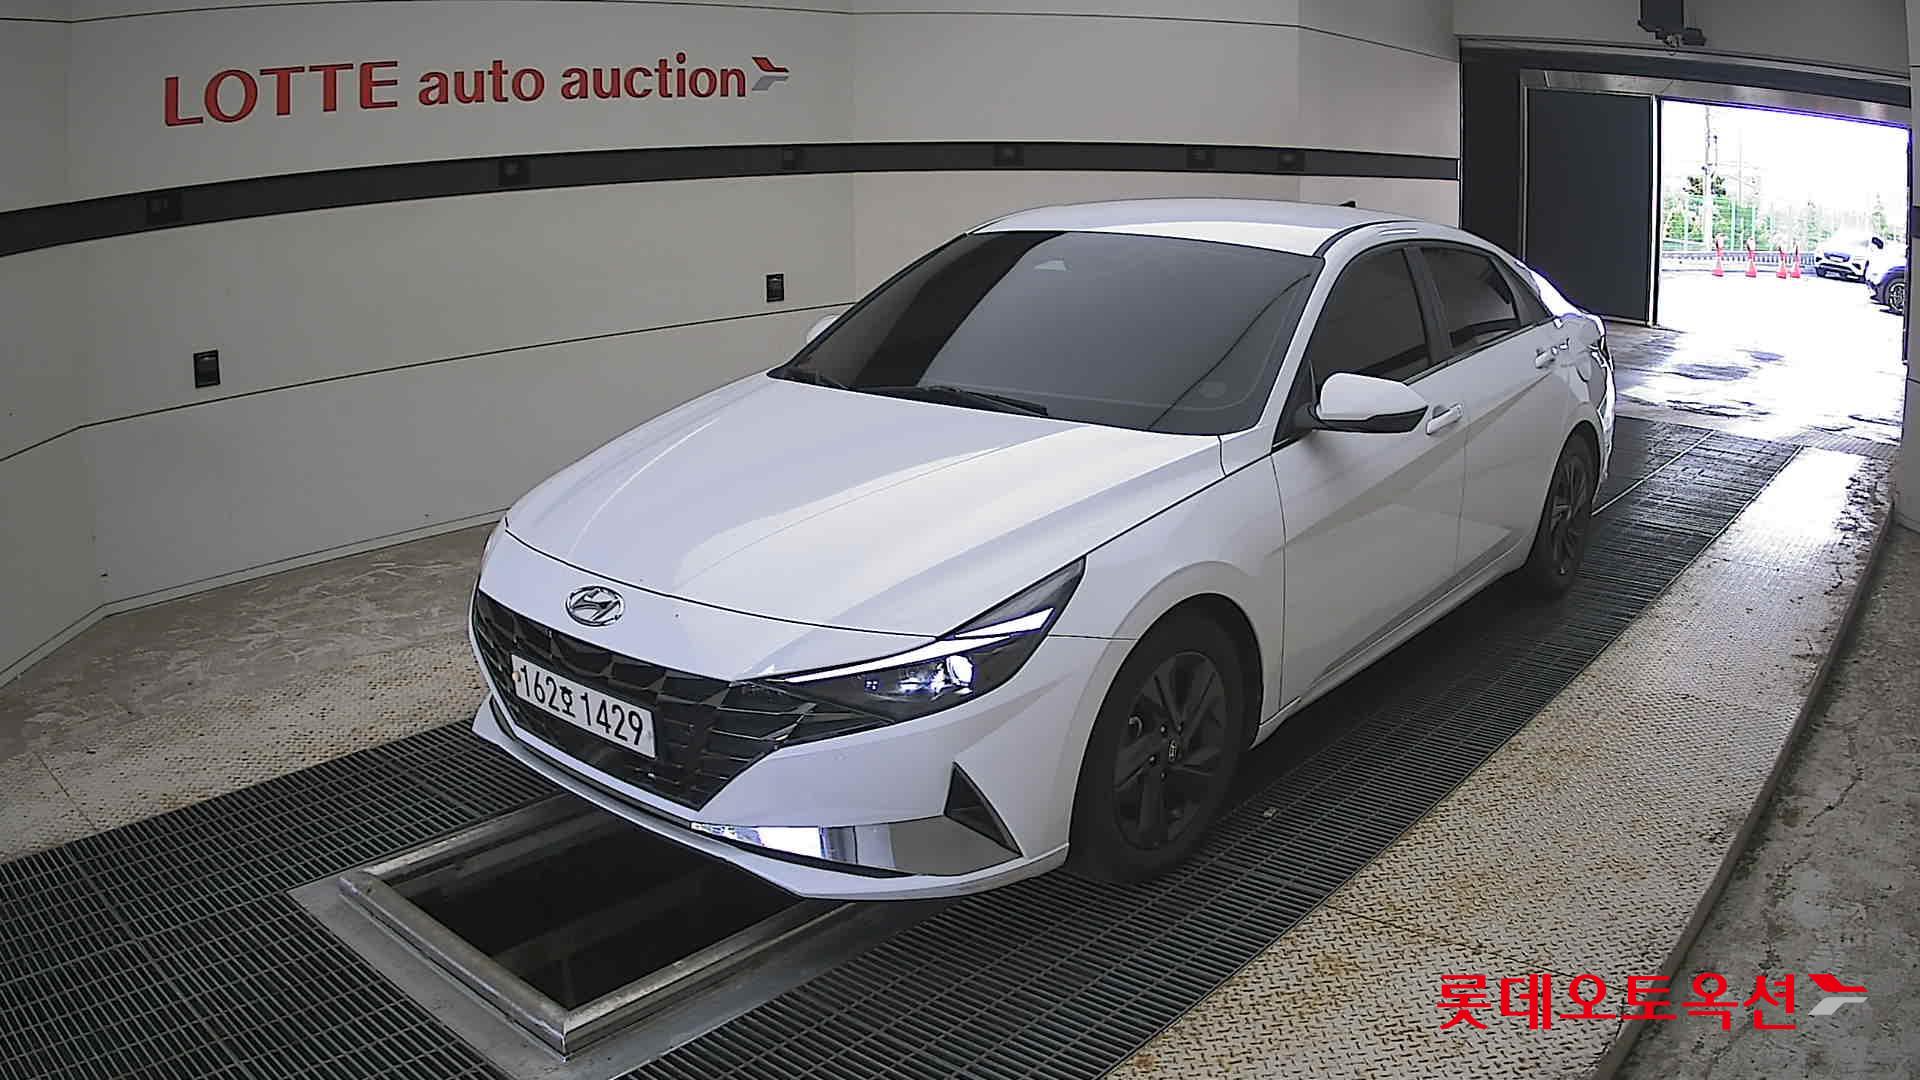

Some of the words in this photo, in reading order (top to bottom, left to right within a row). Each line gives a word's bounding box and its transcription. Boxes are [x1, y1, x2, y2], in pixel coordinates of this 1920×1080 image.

[164, 61, 399, 127] LOTTE
[418, 60, 545, 106] auto
[560, 52, 747, 99] auction
[580, 692, 643, 746] 1429
